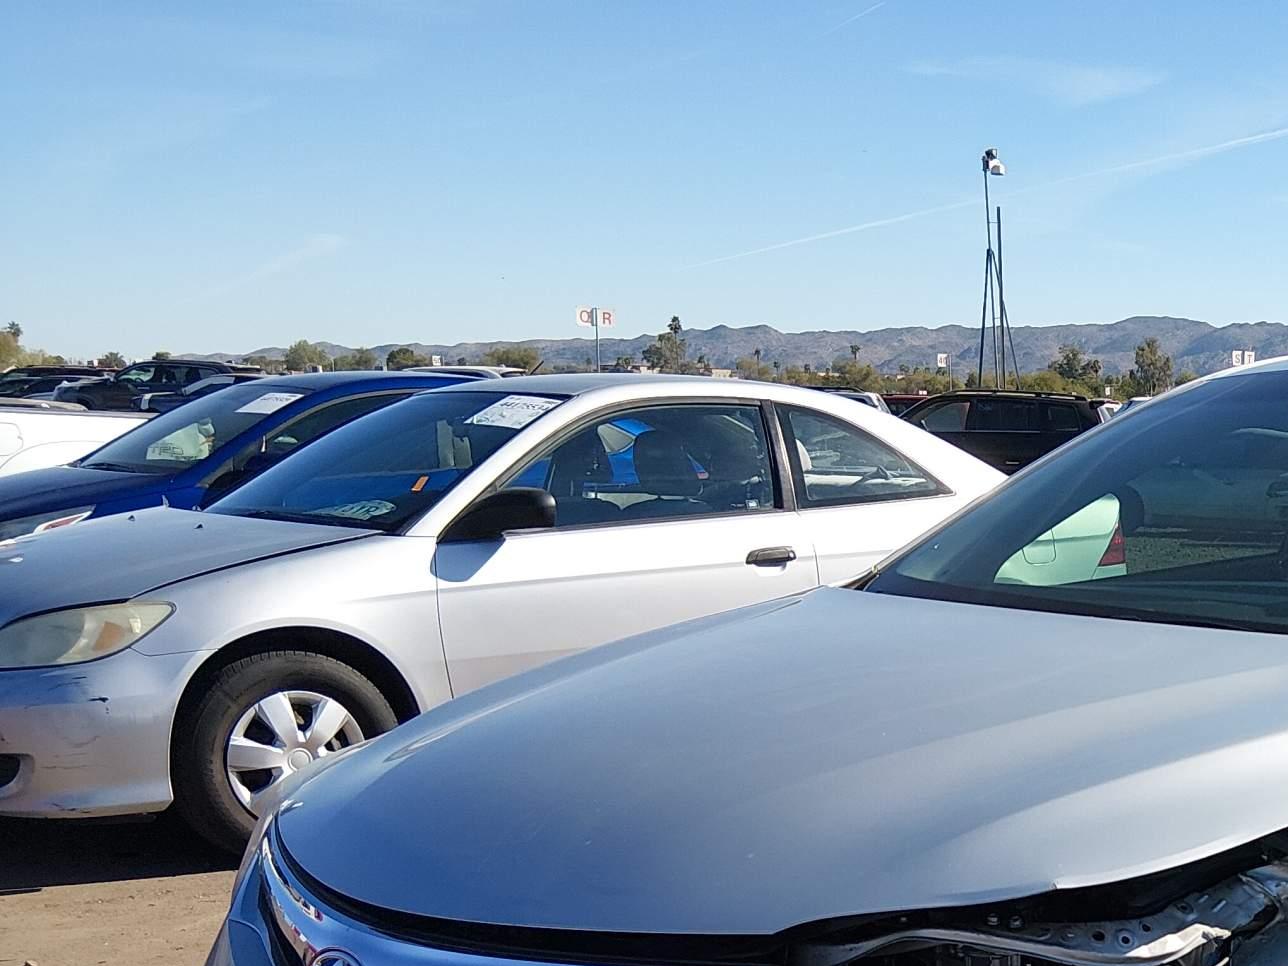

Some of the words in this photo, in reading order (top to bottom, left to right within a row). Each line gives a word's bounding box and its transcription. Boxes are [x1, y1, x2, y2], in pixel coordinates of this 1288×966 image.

[602, 312, 612, 325] R
[1234, 353, 1241, 364] S
[1246, 354, 1253, 364] T
